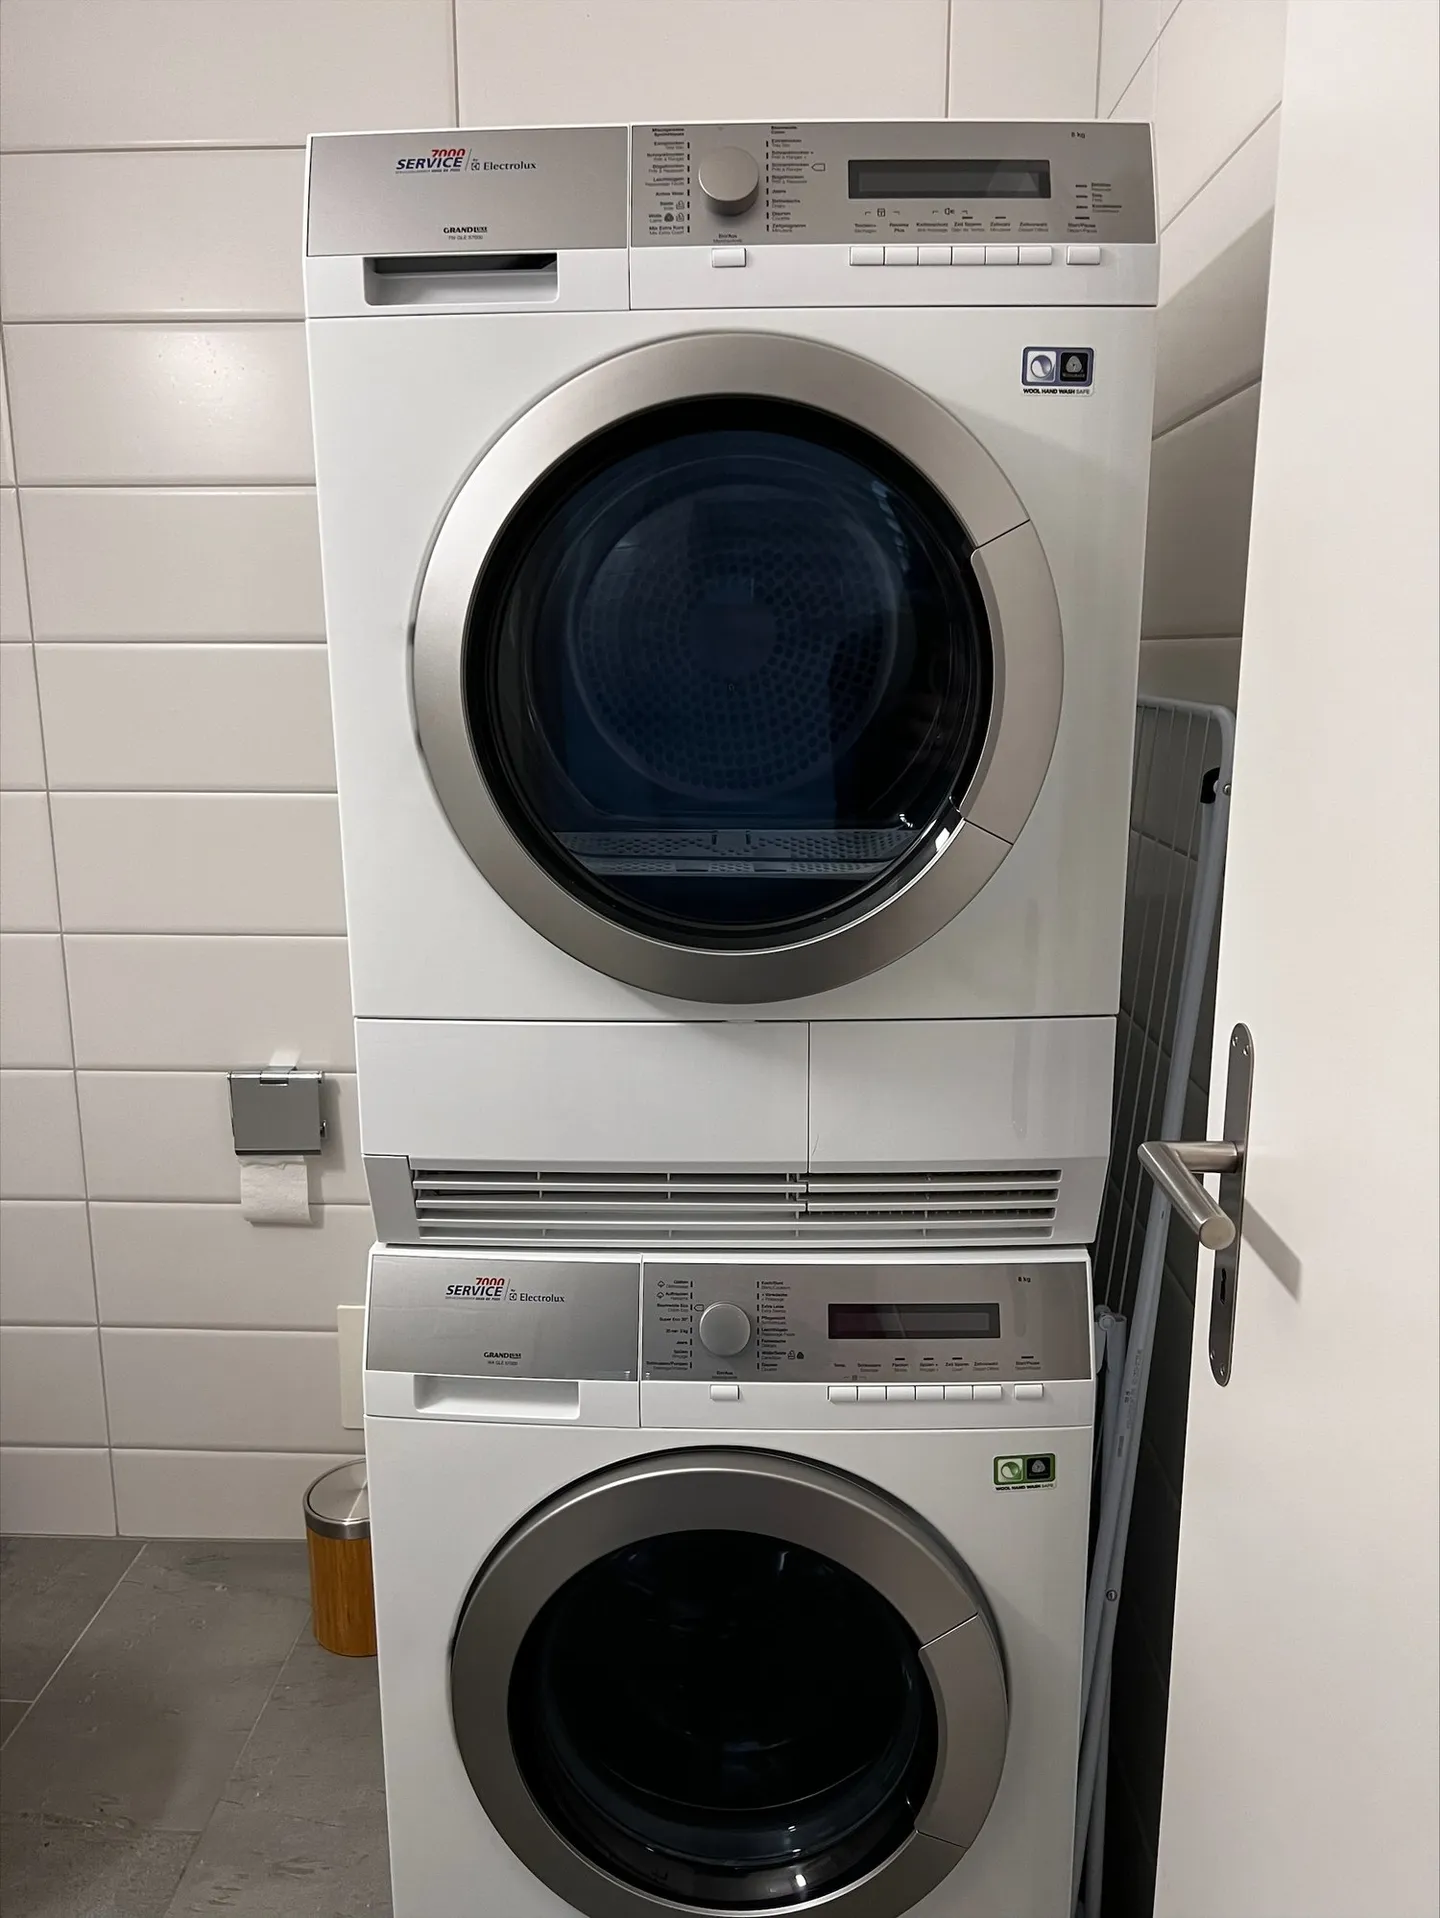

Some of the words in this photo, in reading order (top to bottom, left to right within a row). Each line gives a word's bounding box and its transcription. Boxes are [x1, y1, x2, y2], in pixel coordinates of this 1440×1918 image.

[396, 157, 464, 170] SERVICE
[483, 160, 536, 171] Electrolux
[446, 1284, 503, 1297] SERVICE
[520, 1292, 565, 1303] Electrolux
